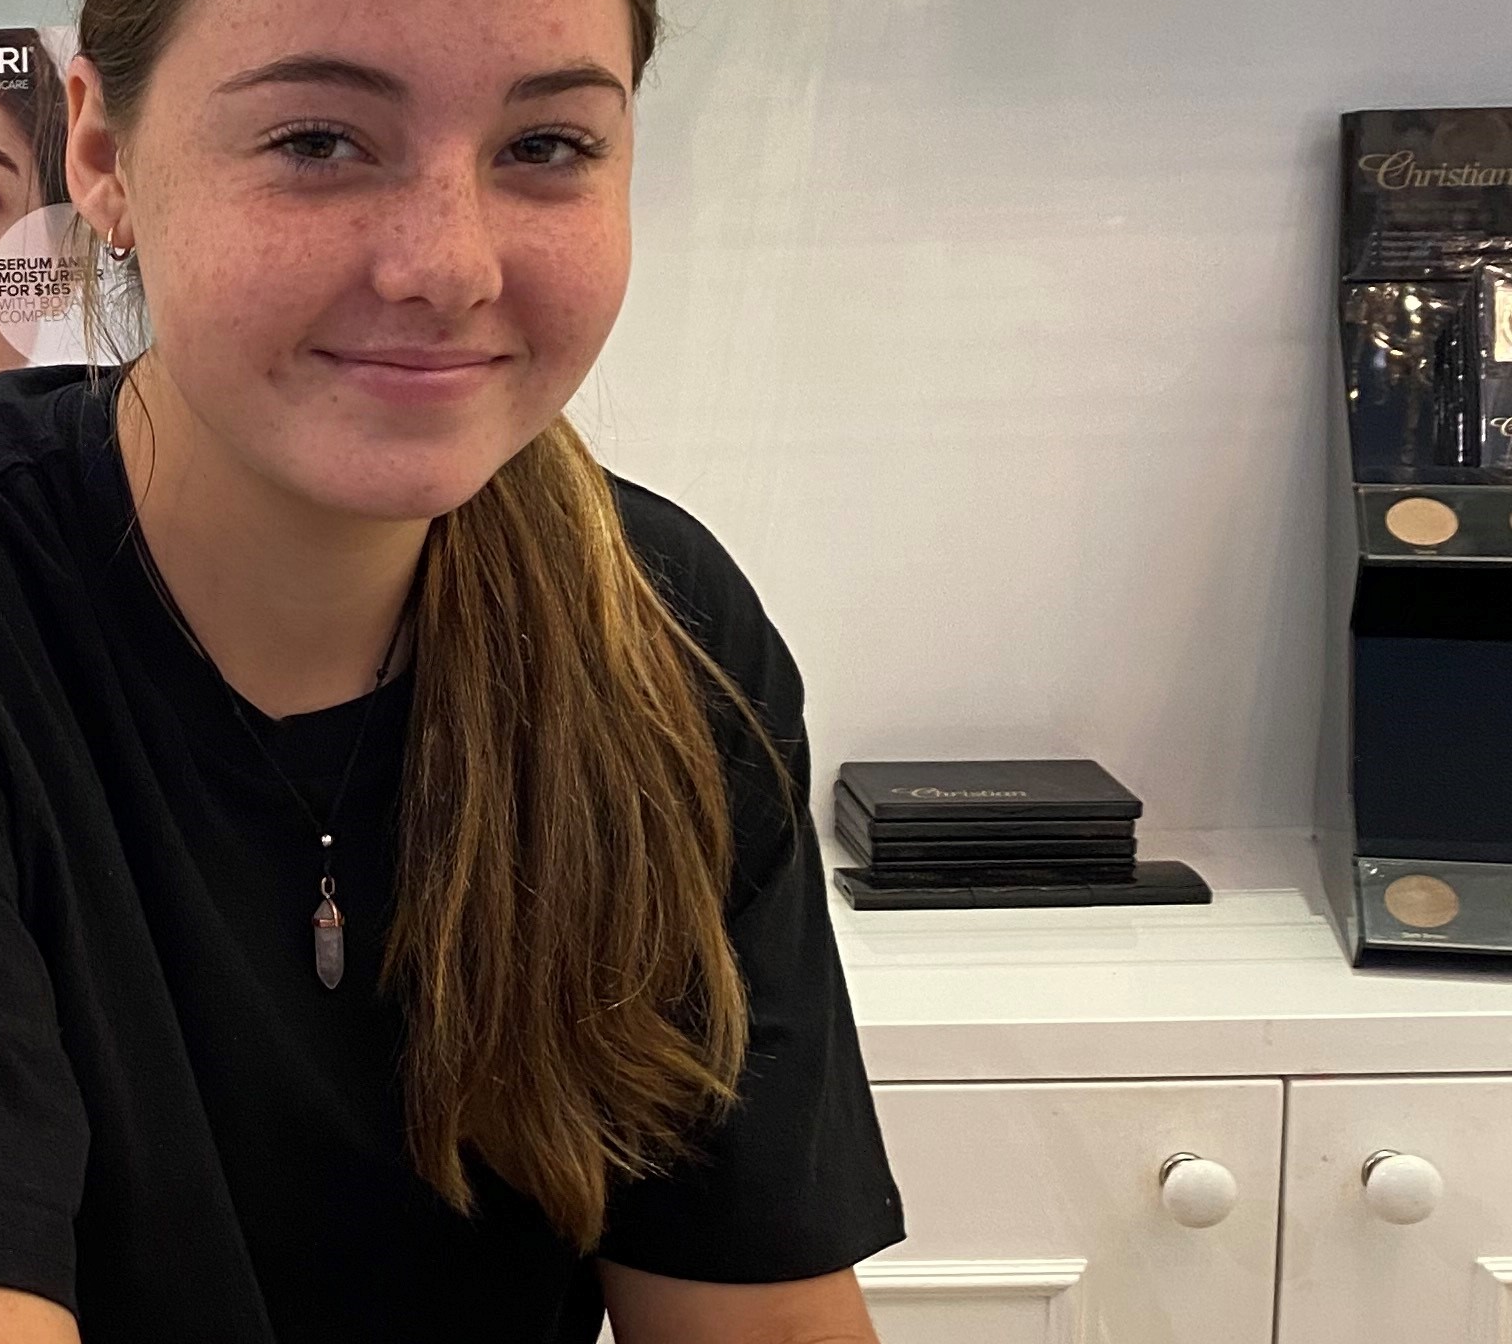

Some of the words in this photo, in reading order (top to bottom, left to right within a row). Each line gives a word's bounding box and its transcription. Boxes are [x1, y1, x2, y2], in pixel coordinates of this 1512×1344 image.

[58, 257, 79, 269] AN
[34, 283, 71, 297] $165
[0, 297, 36, 310] WITH
[0, 310, 72, 324] COMPLEX
[890, 786, 1028, 799] Christian
